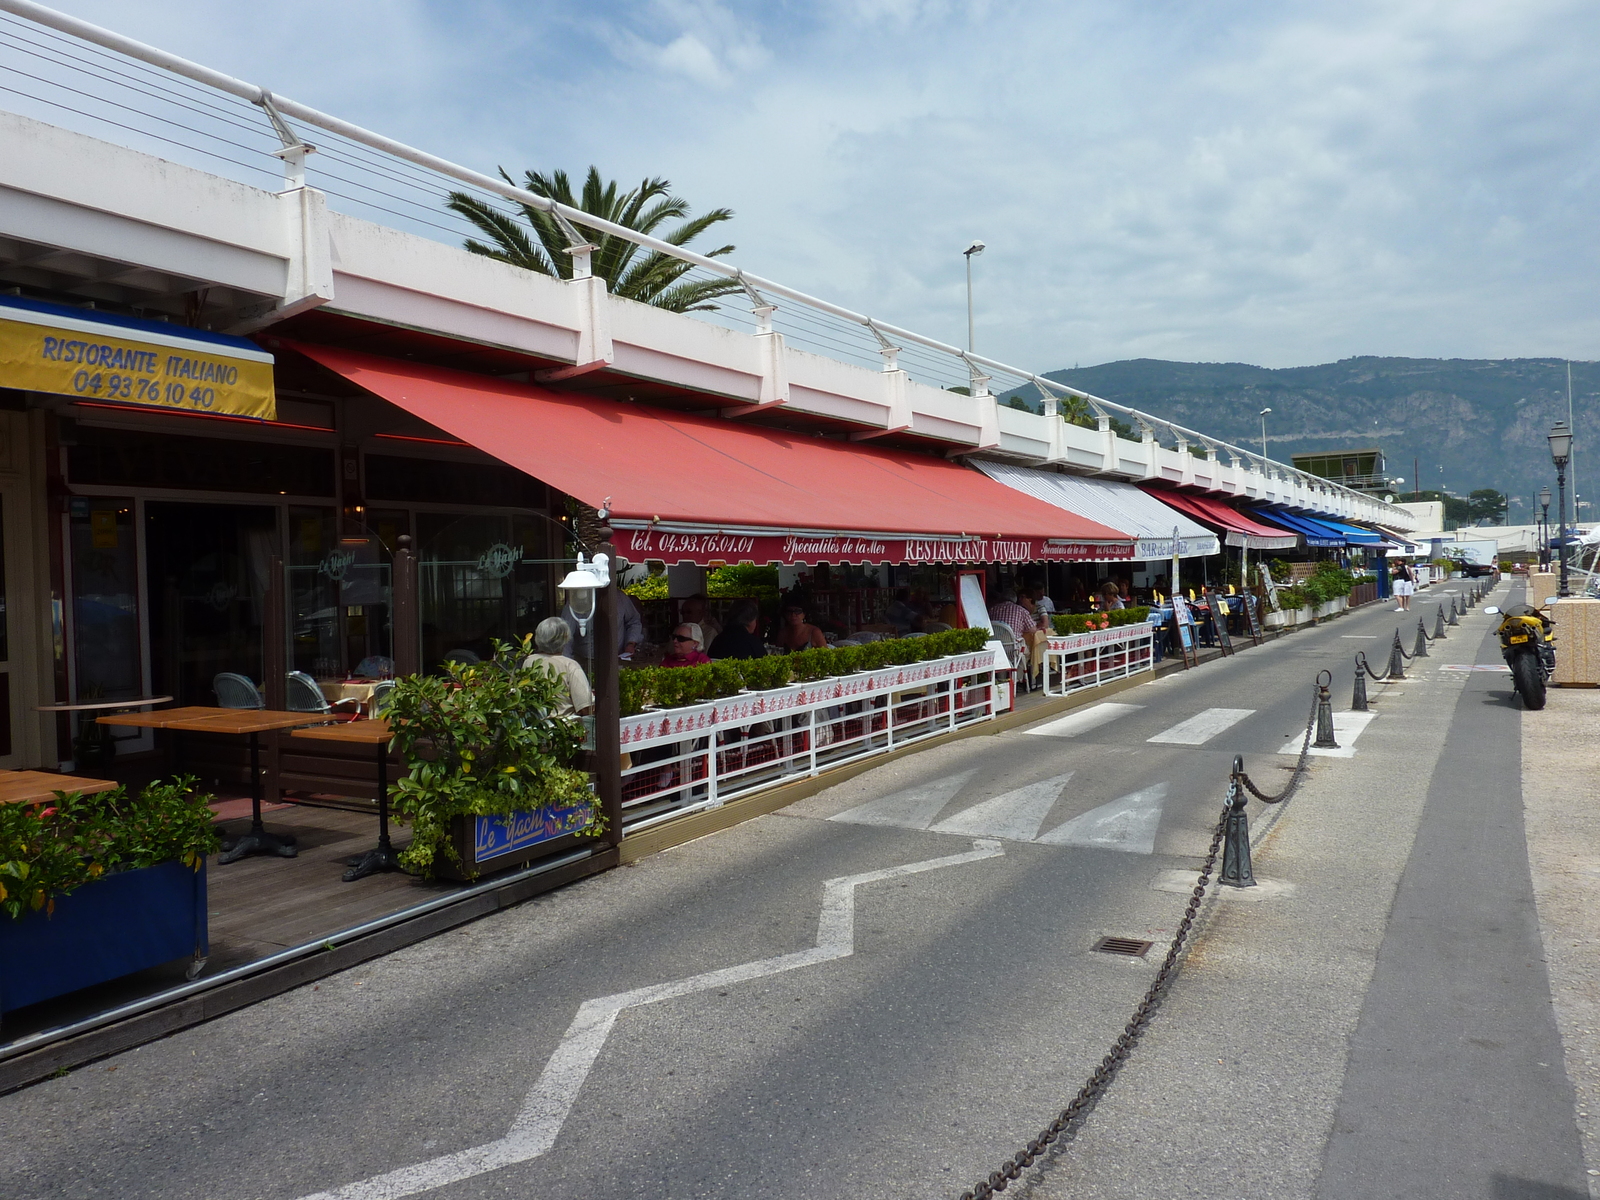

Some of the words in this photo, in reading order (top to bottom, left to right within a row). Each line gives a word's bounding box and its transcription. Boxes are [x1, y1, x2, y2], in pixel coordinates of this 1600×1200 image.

[43, 337, 157, 374] RISTORANTE
[165, 355, 238, 386] ITALIANO
[74, 370, 102, 393] 04
[107, 375, 131, 398] 93
[137, 378, 159, 401] 76
[165, 382, 184, 404] 10
[189, 387, 215, 408] 40
[659, 533, 754, 553] 04.93.76.01.01
[841, 538, 853, 554] de
[855, 538, 866, 554] la
[867, 540, 886, 554] Mer
[904, 540, 988, 560] RESTAURANT
[992, 541, 1032, 560] VIVALDI
[1141, 543, 1157, 557] BAR
[1158, 543, 1165, 556] de
[476, 817, 495, 852] Le
[506, 807, 545, 850] Yacht
